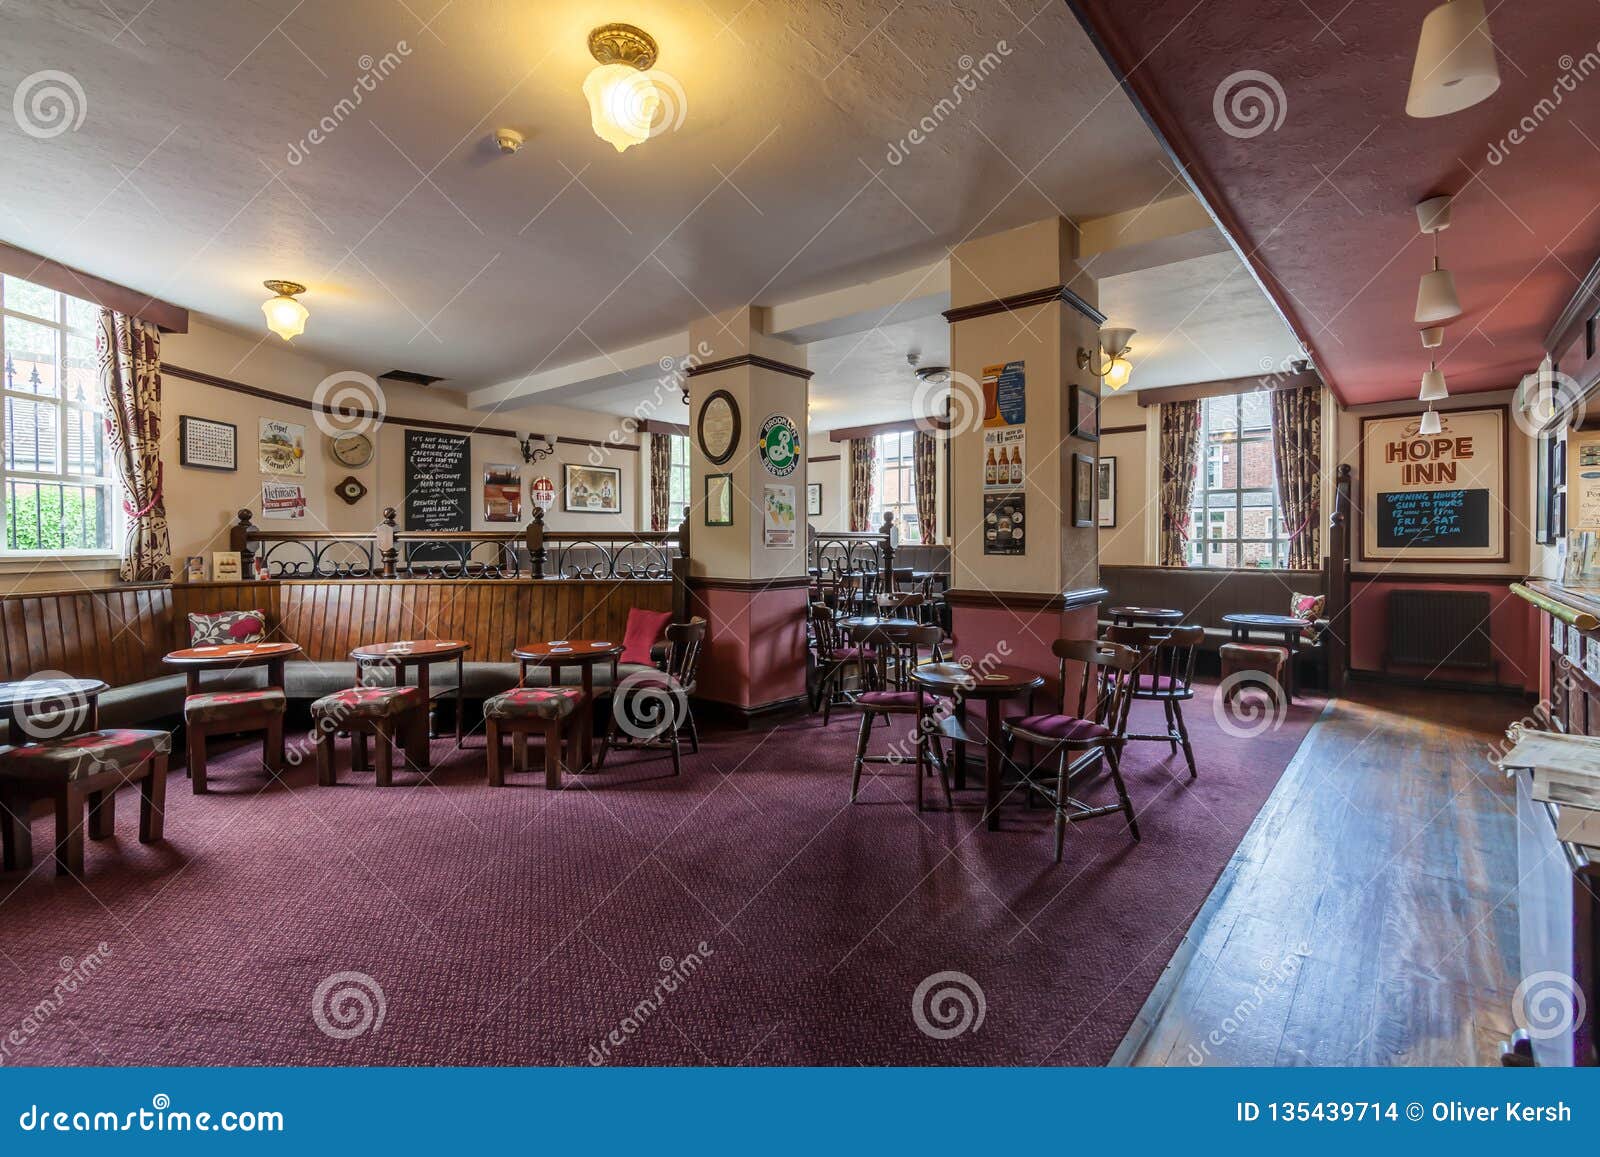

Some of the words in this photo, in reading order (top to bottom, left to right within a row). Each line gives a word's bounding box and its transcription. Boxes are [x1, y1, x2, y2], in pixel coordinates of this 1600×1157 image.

[764, 416, 797, 437] BROOKLYN
[1386, 436, 1474, 464] HOPE
[763, 456, 796, 476] BREWERY
[1402, 462, 1457, 485] INN
[1395, 502, 1416, 510] SUN
[1421, 517, 1428, 525] &
[1433, 516, 1459, 524] SAT
[1435, 525, 1448, 534] 12
